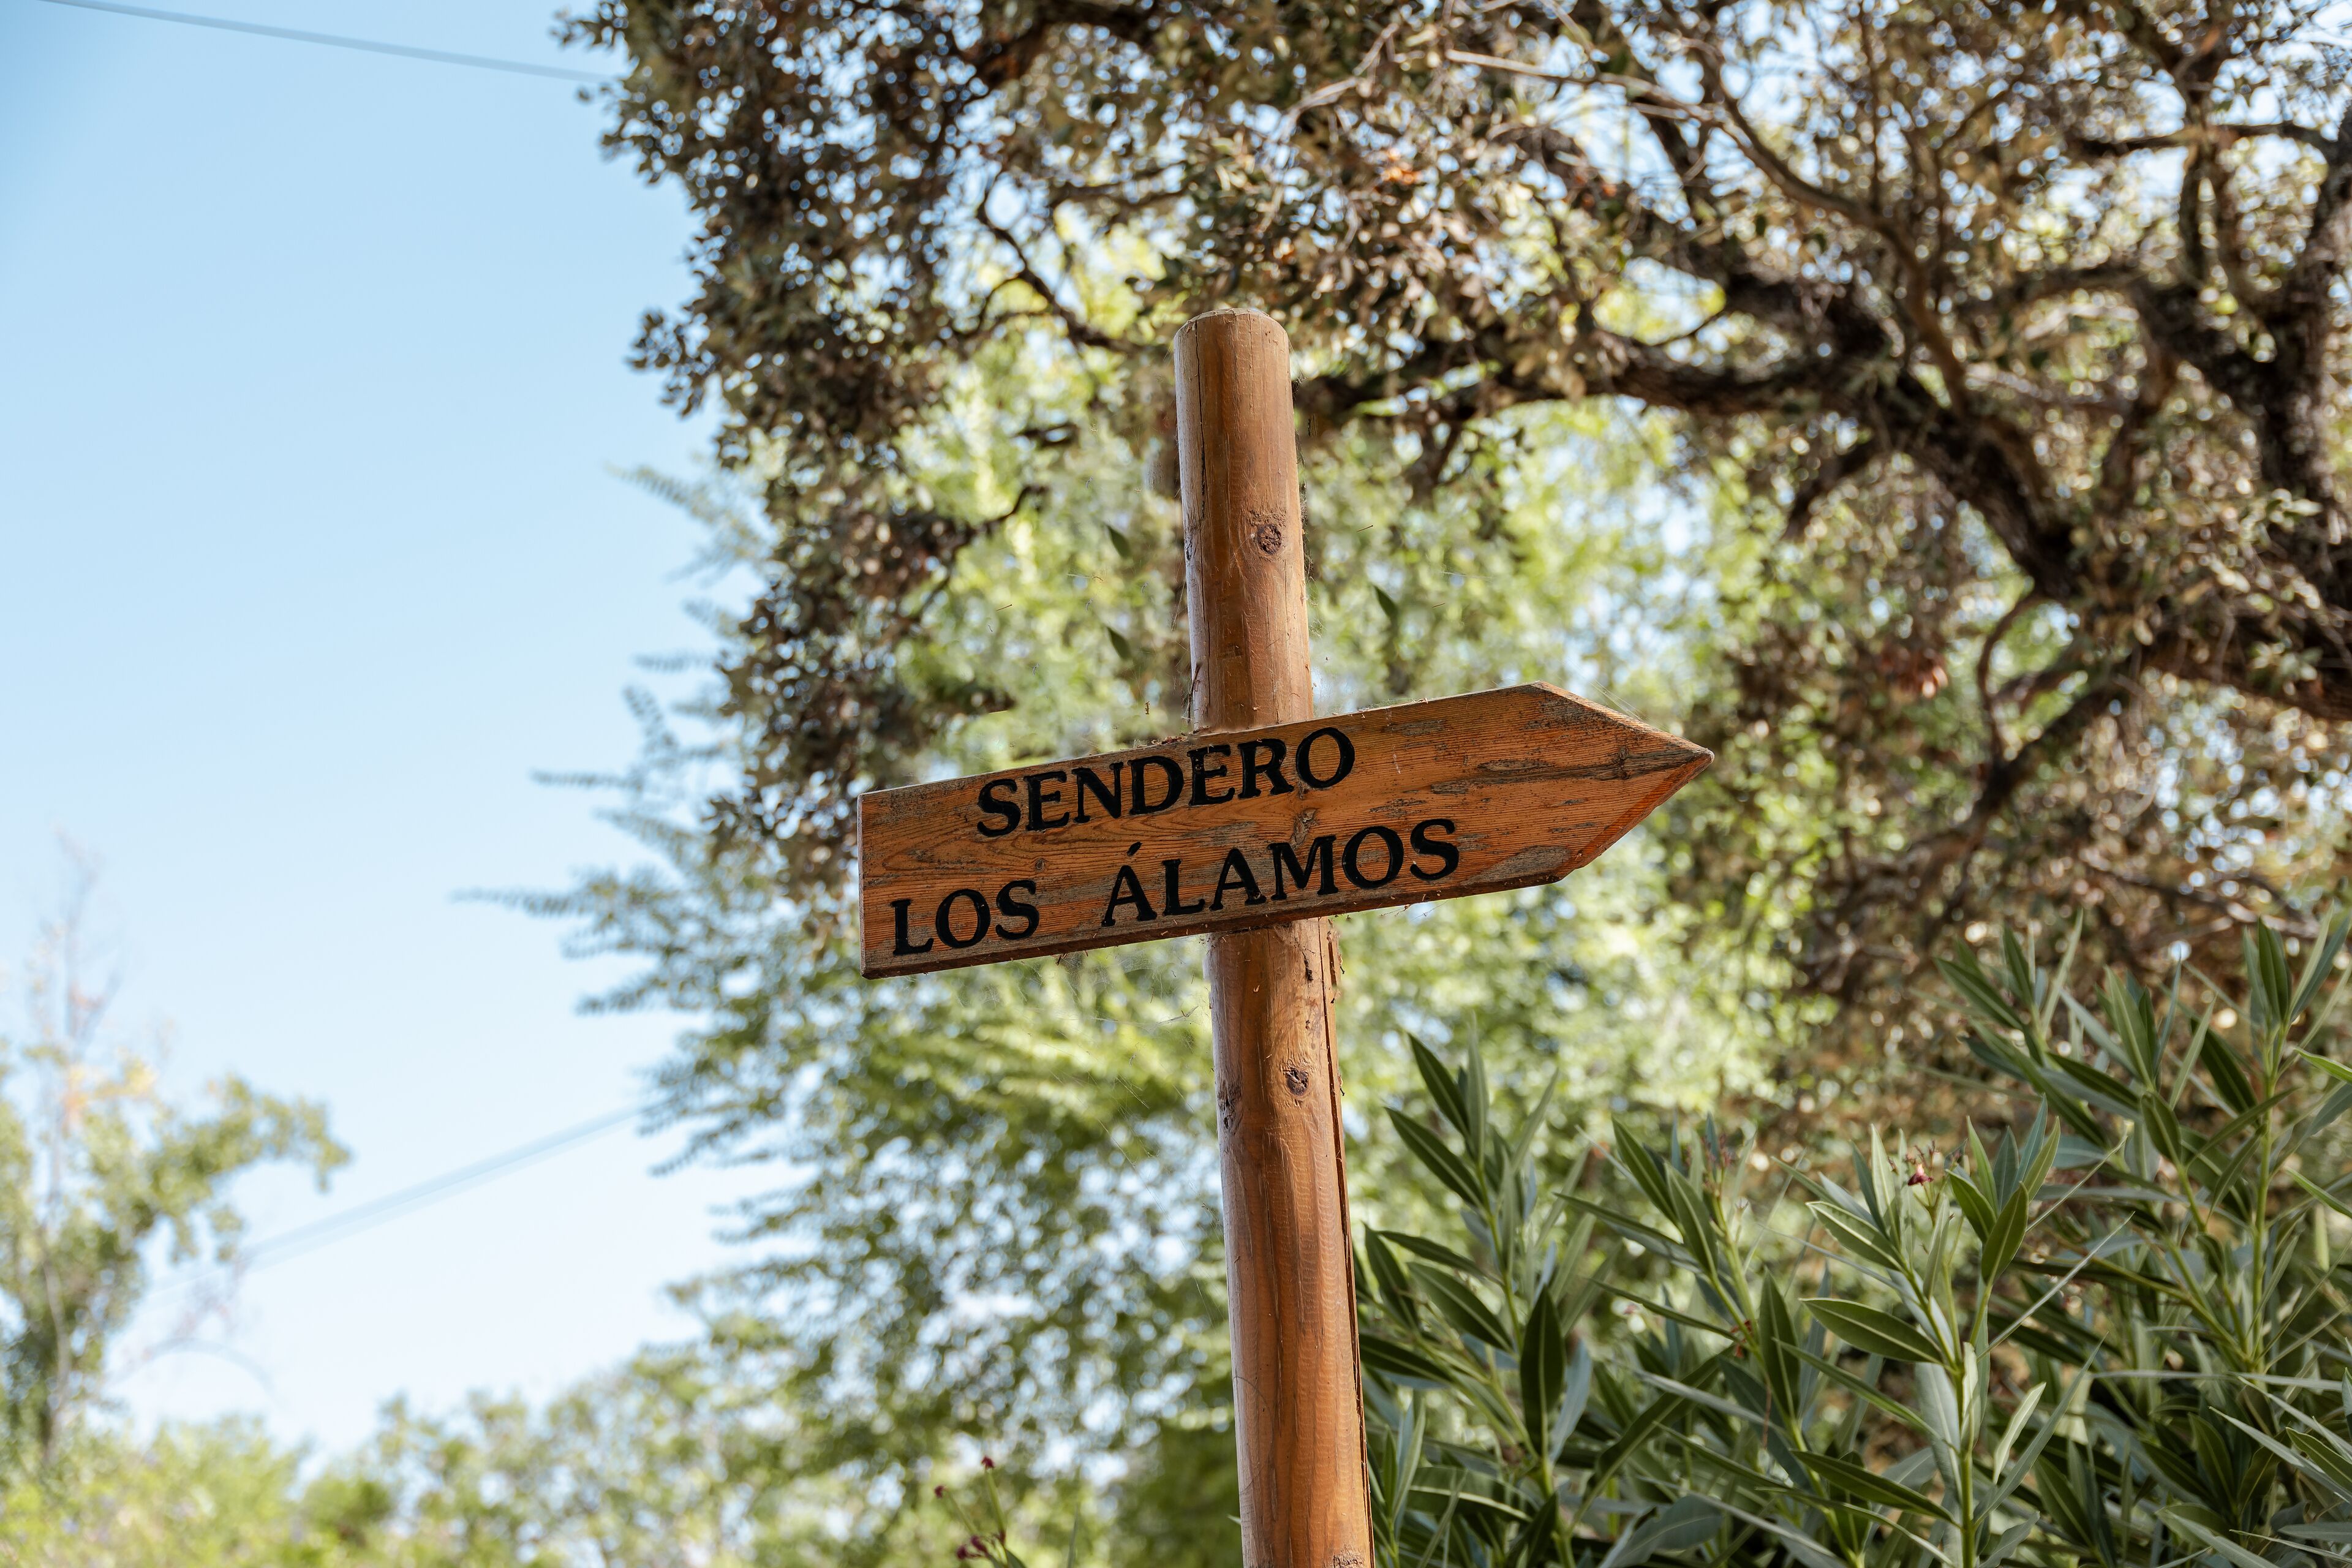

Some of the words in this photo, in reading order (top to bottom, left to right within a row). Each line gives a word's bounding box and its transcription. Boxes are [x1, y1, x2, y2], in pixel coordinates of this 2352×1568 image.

[976, 726, 1355, 837] SENDERO
[890, 880, 1040, 956] LOS
[1102, 818, 1460, 926] ÁLAMOS
